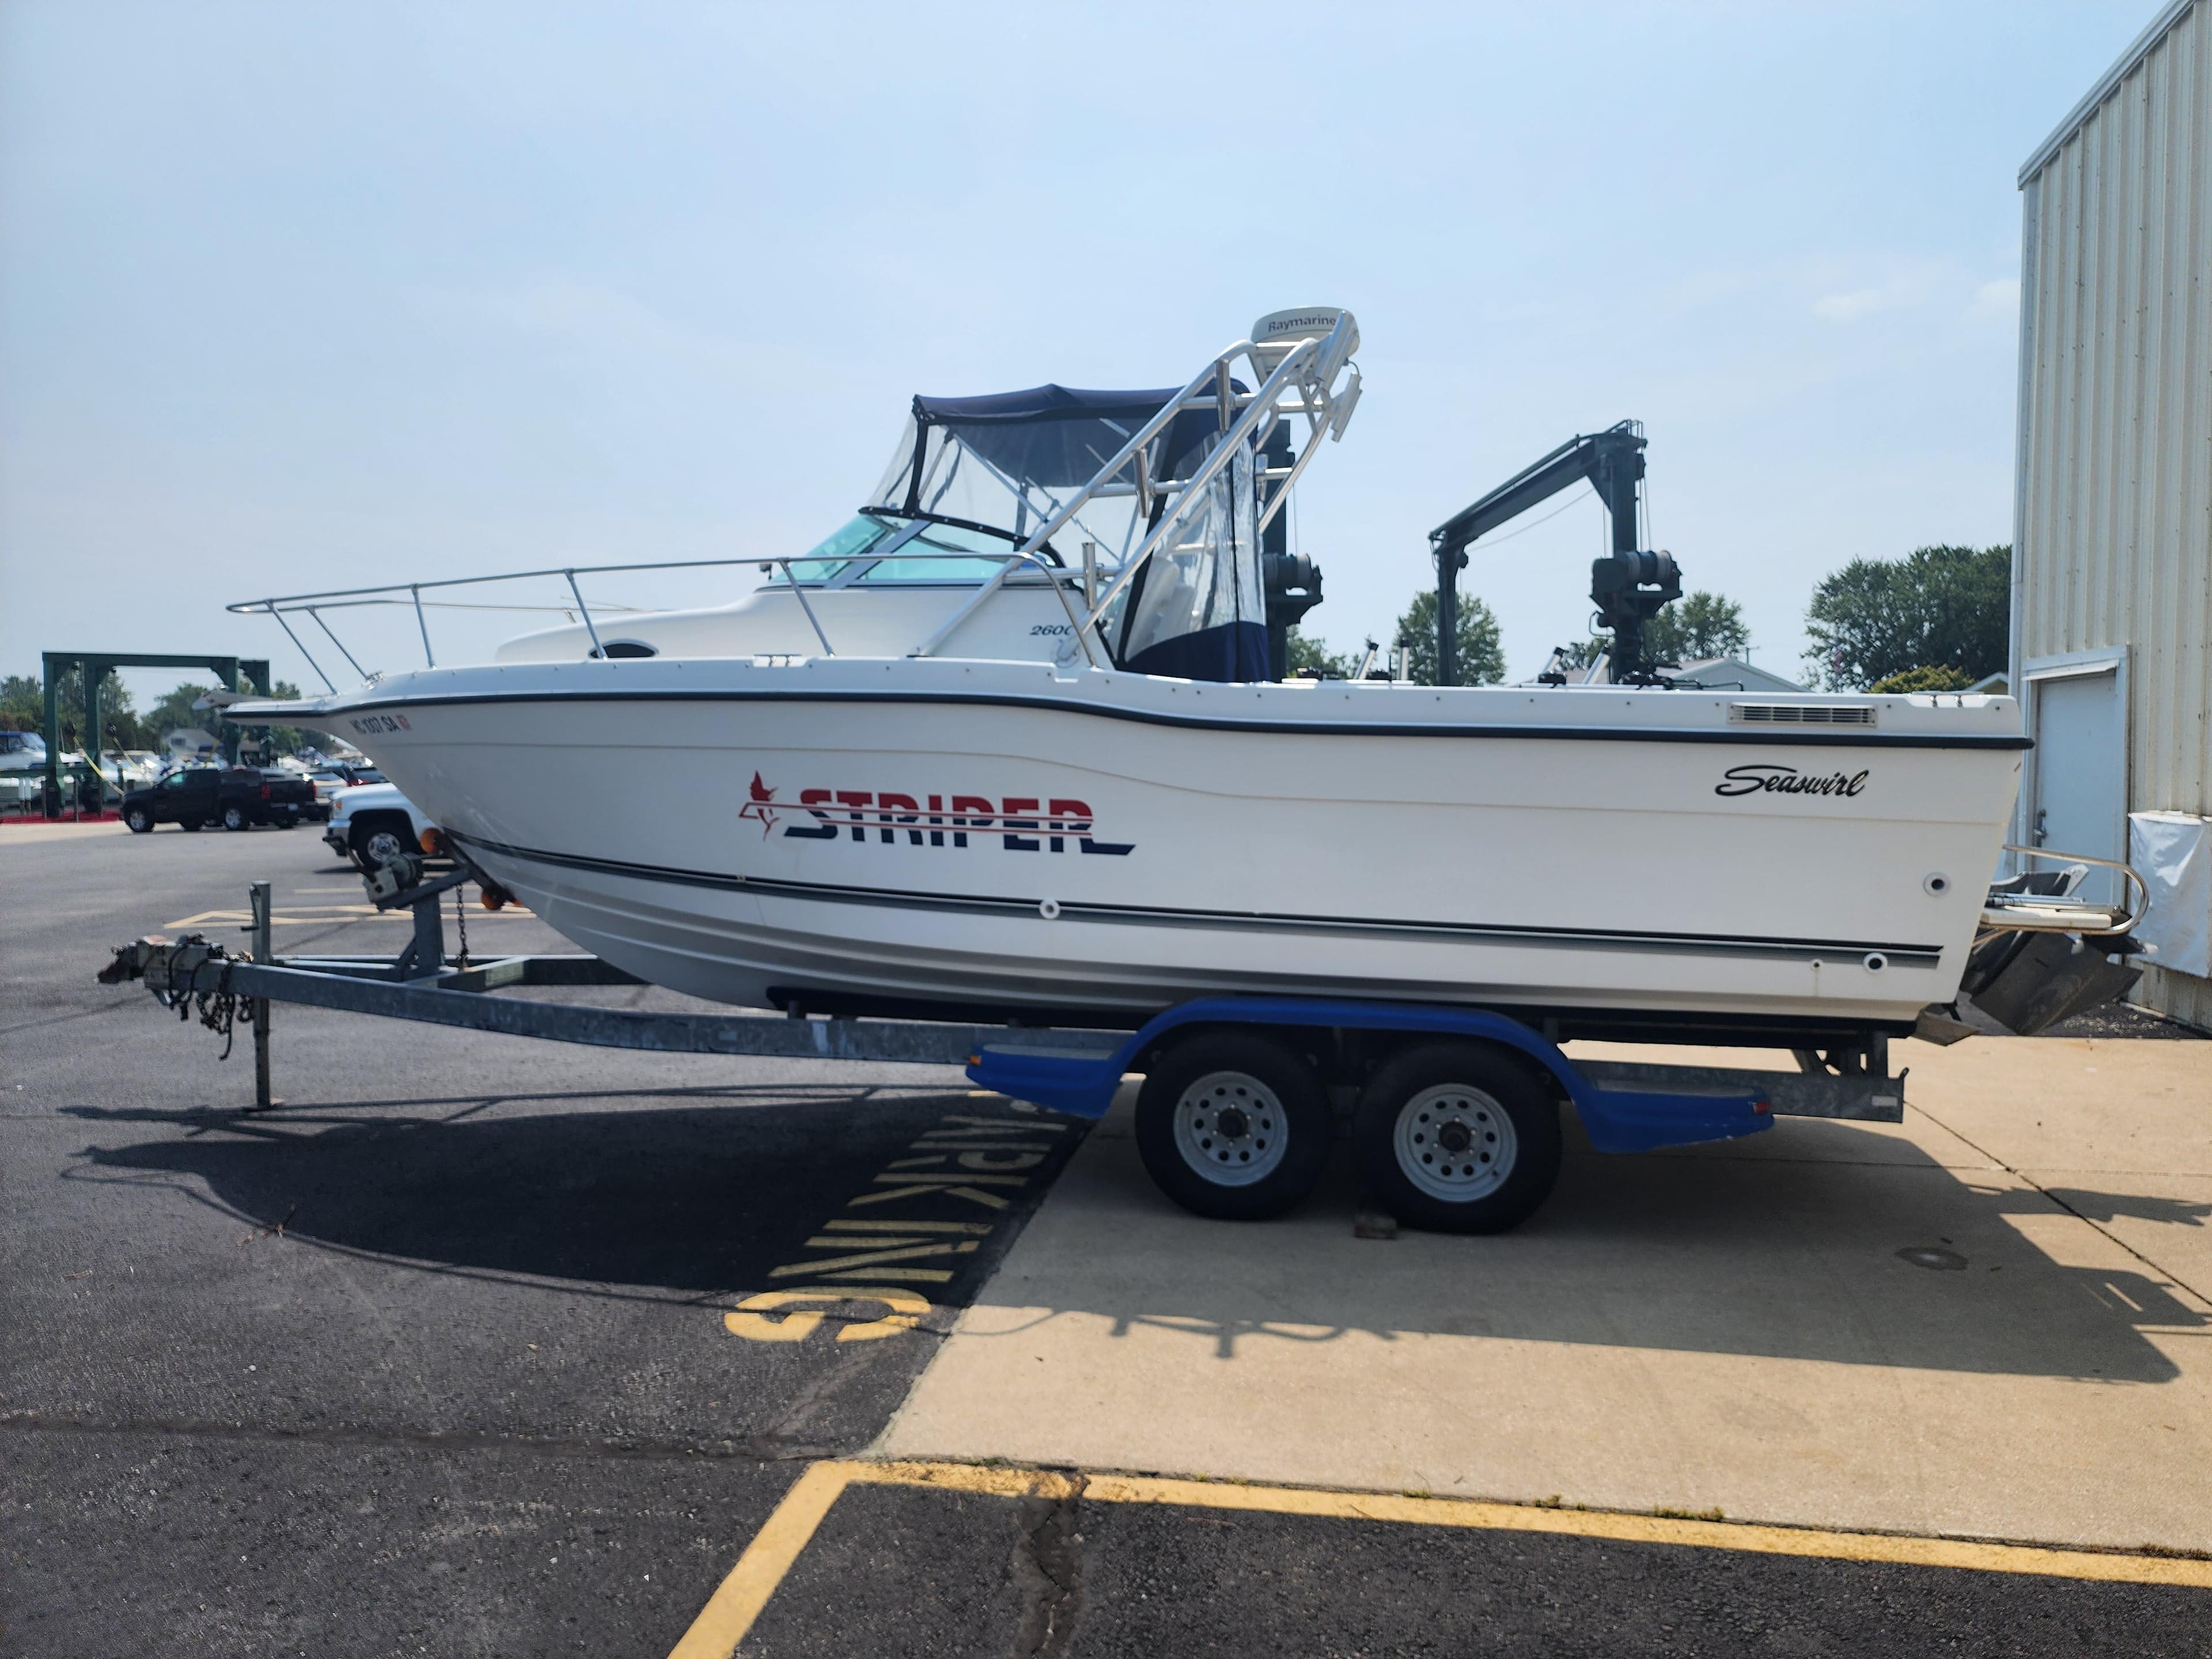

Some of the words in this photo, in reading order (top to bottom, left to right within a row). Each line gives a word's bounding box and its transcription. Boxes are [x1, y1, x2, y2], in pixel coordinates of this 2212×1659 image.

[1268, 315, 1336, 332] Raymarine
[381, 714, 402, 732] SA
[1715, 764, 1869, 797] Seaswirl
[784, 789, 1136, 855] STRIPER
